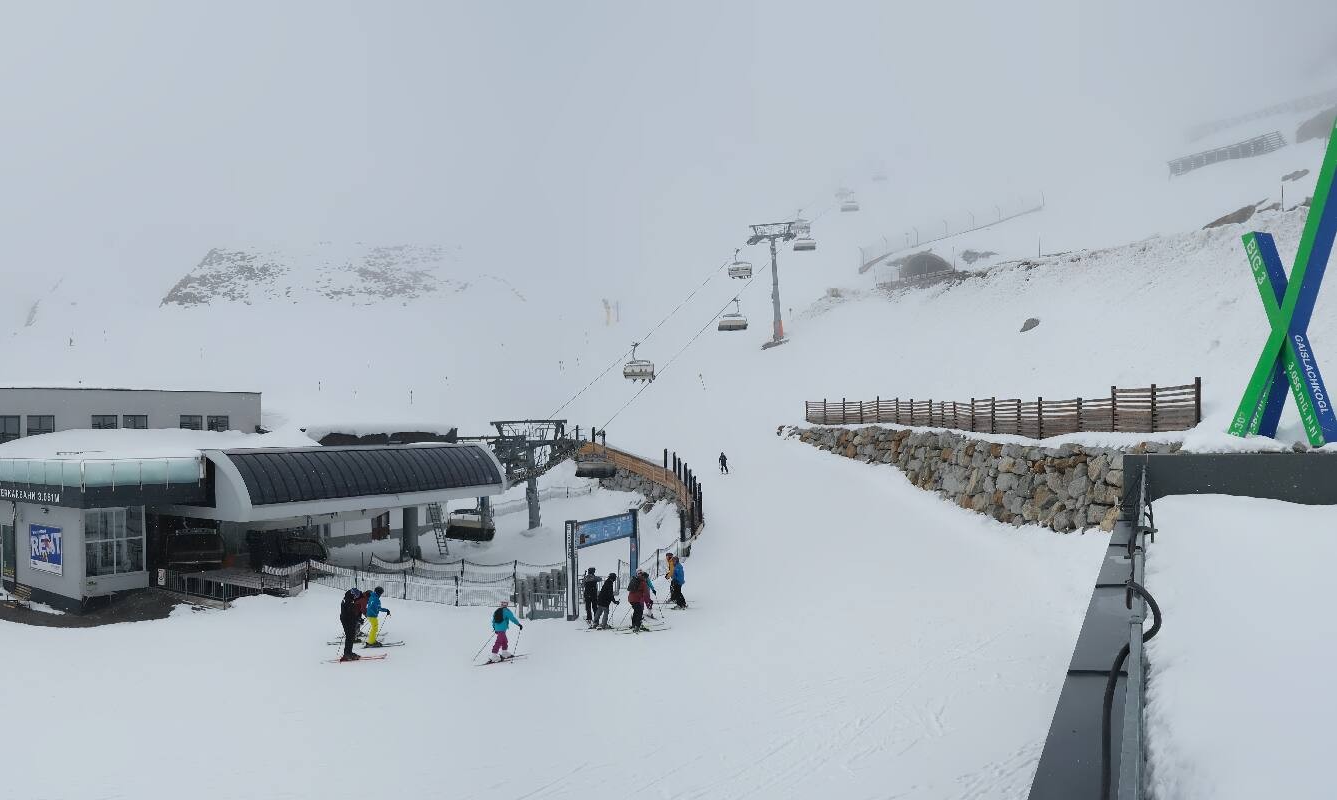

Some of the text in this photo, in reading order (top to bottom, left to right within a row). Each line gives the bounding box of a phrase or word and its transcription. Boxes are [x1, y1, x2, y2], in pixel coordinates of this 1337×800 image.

[1247, 238, 1267, 286] BIG 3
[1294, 334, 1329, 415] GAISLACHKOGL
